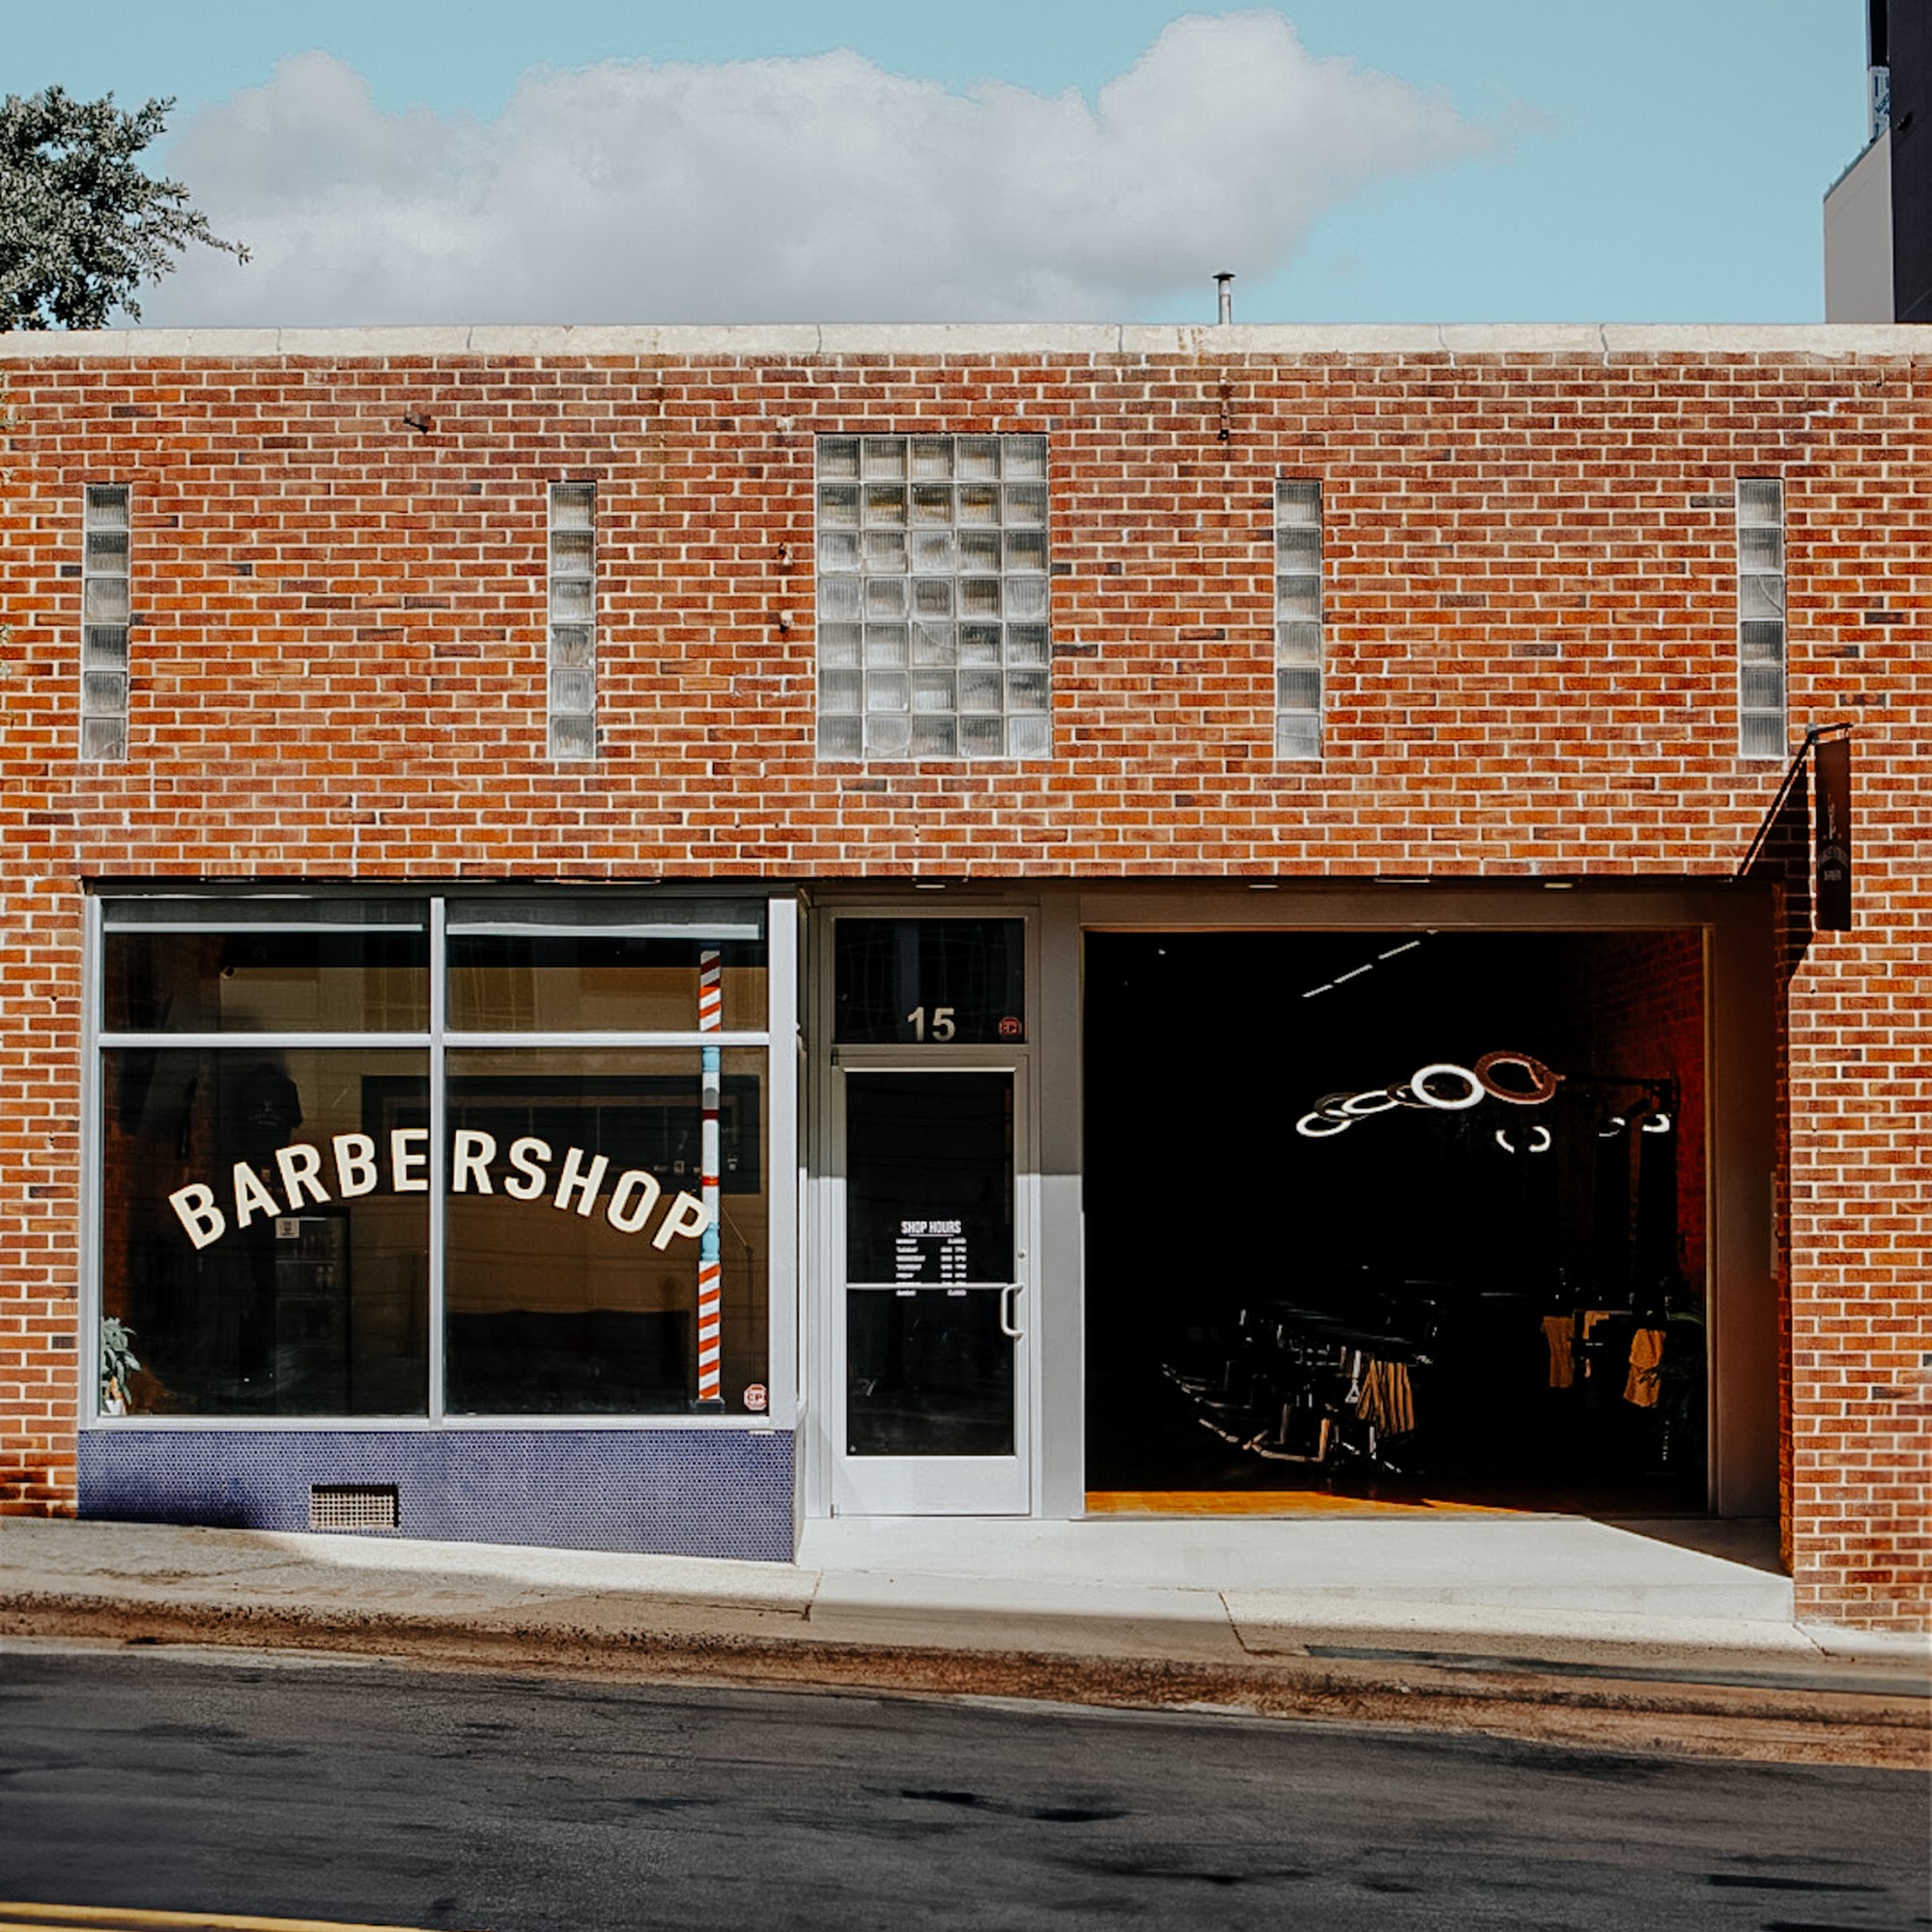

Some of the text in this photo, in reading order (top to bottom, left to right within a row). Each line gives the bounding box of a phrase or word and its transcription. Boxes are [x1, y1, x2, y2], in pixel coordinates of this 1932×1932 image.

[907, 1007, 956, 1041] 15
[168, 1128, 712, 1251] BARBERSHOP
[900, 1220, 962, 1234] SHOP HOURS
